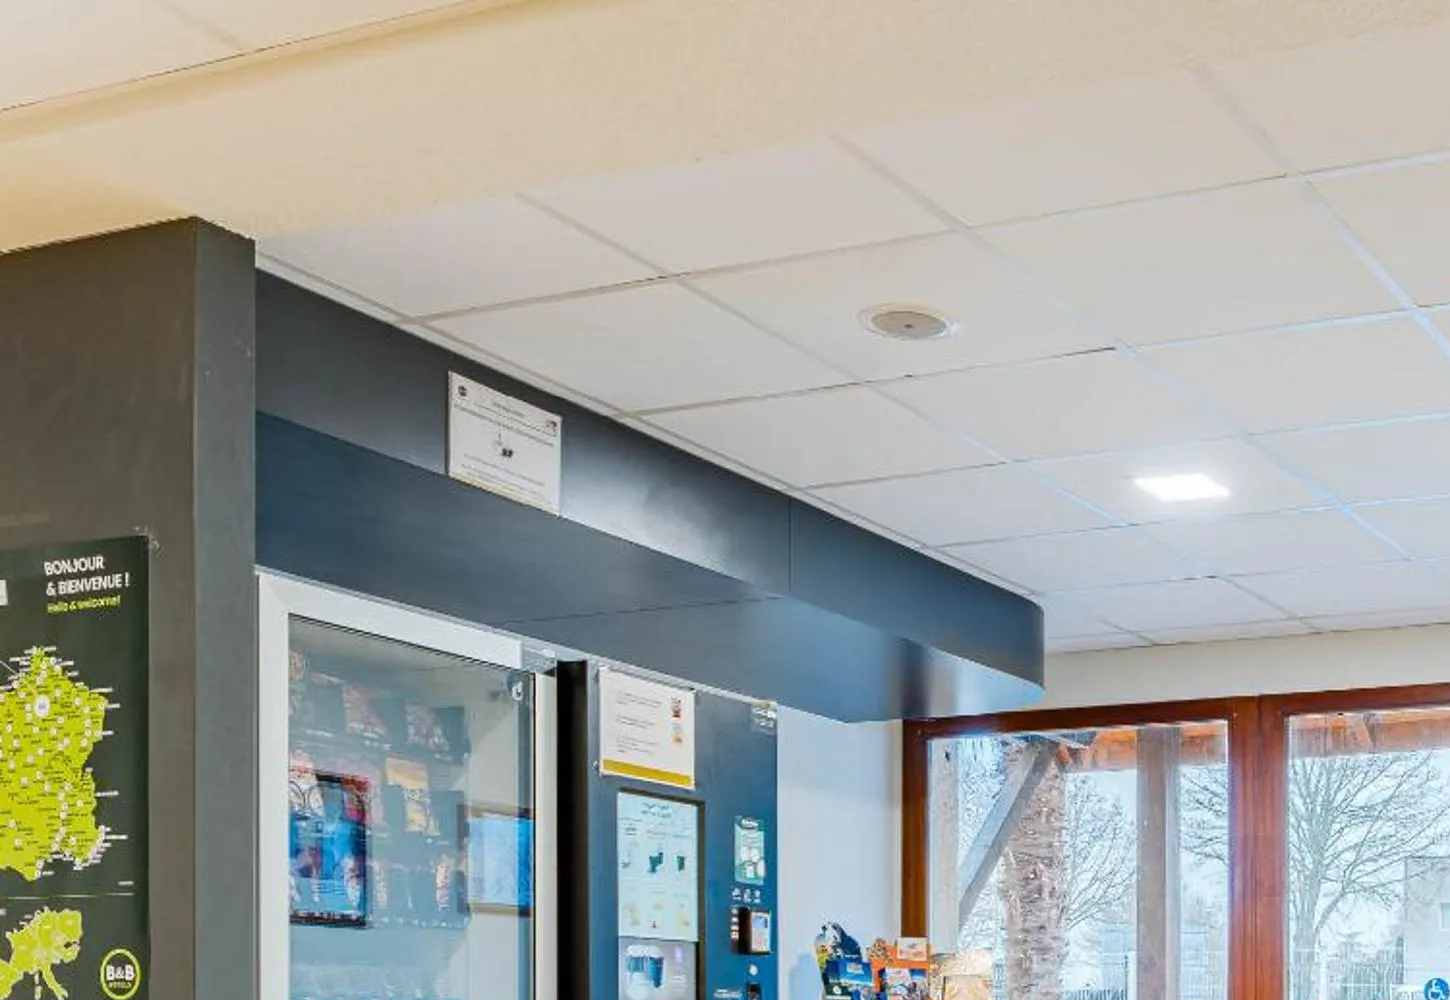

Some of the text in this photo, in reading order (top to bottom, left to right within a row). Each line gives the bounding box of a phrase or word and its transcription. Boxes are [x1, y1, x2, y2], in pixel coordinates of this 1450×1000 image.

[44, 556, 105, 576] BONJOUR
[46, 582, 57, 596] &
[58, 574, 122, 595] BIENVENUE
[106, 964, 135, 981] B&B
